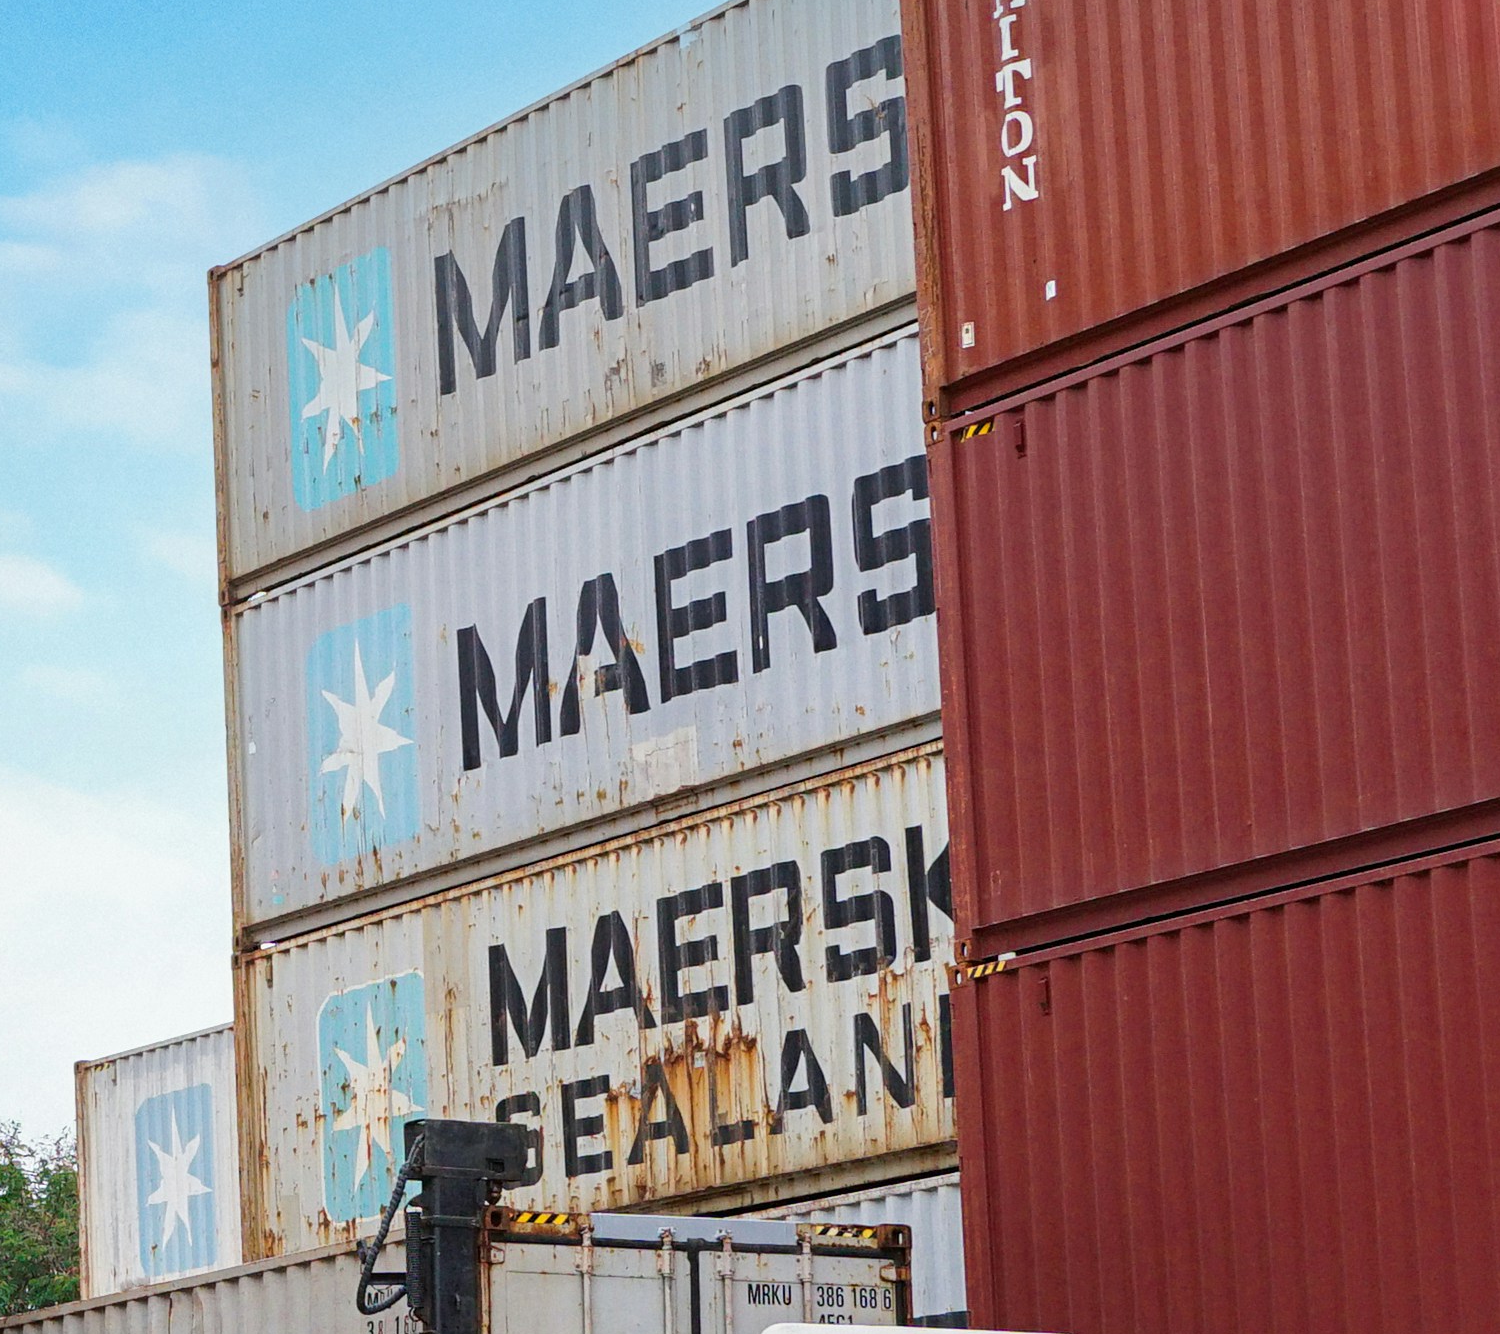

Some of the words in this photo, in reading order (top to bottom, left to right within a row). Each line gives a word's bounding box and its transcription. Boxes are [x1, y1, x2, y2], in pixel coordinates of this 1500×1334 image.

[494, 994, 955, 1187] SEALAN
[747, 1284, 792, 1306] MRKU
[816, 1286, 845, 1307] 386
[851, 1288, 878, 1309] 168
